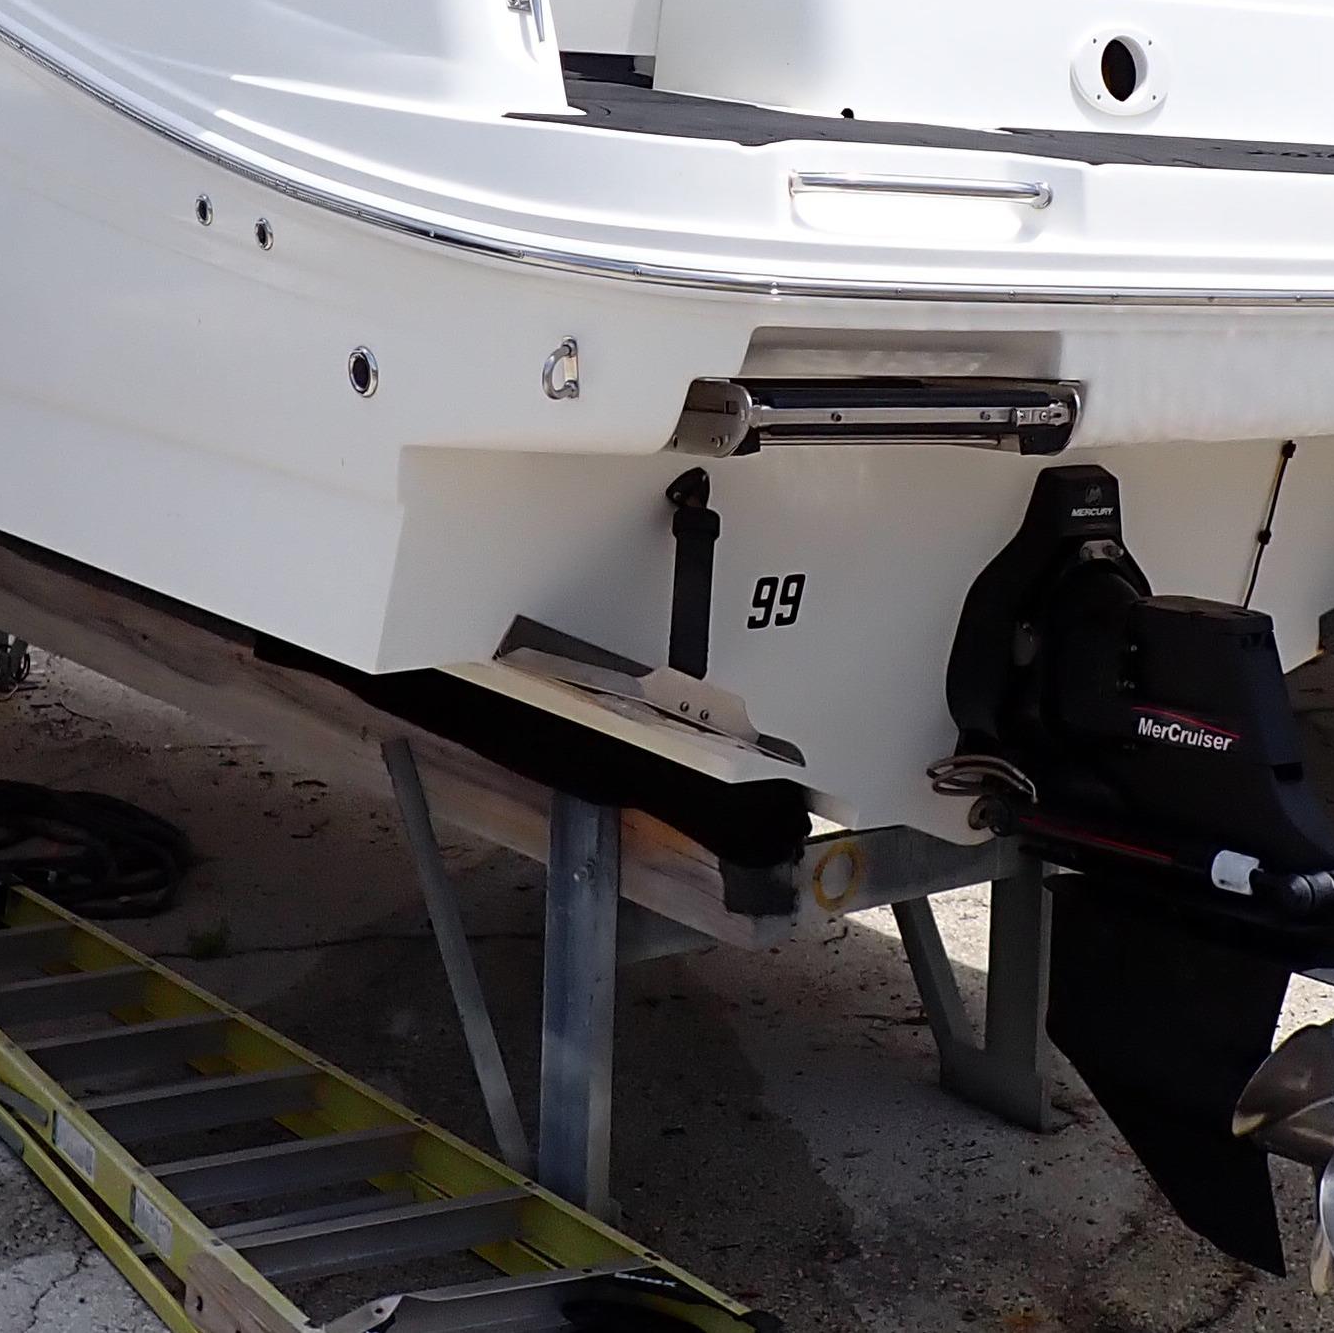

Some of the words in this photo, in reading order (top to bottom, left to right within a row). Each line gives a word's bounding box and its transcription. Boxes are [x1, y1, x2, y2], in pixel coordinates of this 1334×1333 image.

[1070, 506, 1115, 517] MERCURY
[746, 573, 807, 630] 99
[1137, 716, 1234, 752] MerCruiser
